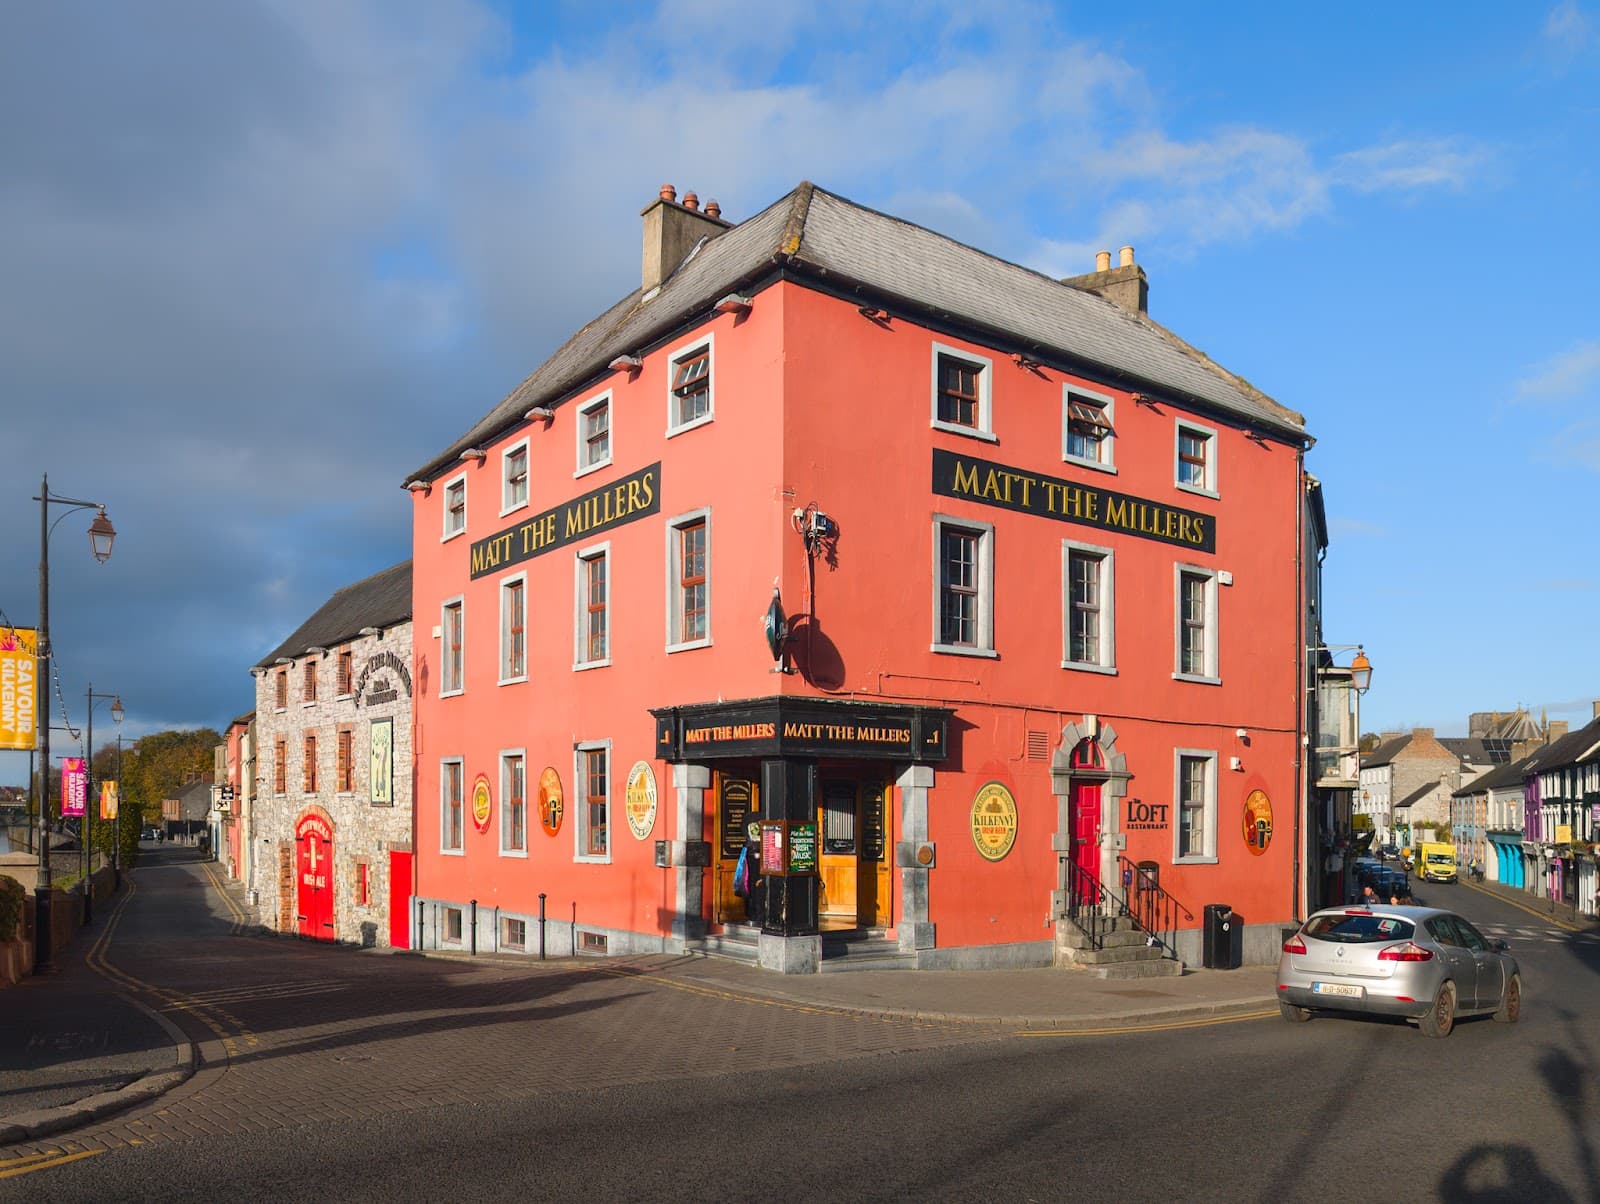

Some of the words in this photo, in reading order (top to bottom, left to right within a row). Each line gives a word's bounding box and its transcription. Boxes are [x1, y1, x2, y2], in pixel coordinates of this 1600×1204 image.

[952, 461, 1036, 507] MATT
[1042, 481, 1098, 521] THE
[1105, 496, 1204, 544] MILLERS
[471, 532, 514, 574] MATT
[520, 513, 556, 554] THE
[565, 472, 653, 539] MILLERS
[2, 658, 15, 732] KILKENNY
[17, 659, 33, 733] SAVOUR
[685, 729, 711, 743] MATT
[712, 727, 732, 741] THE
[733, 723, 776, 740] MILLERS
[784, 722, 823, 738] MATT
[826, 725, 854, 740] THE
[857, 727, 911, 743] MILLERS
[75, 772, 84, 809] SAVOUR
[973, 814, 1014, 826] KILKENNY
[1128, 801, 1168, 822] LOFT
[316, 876, 326, 888] ALE
